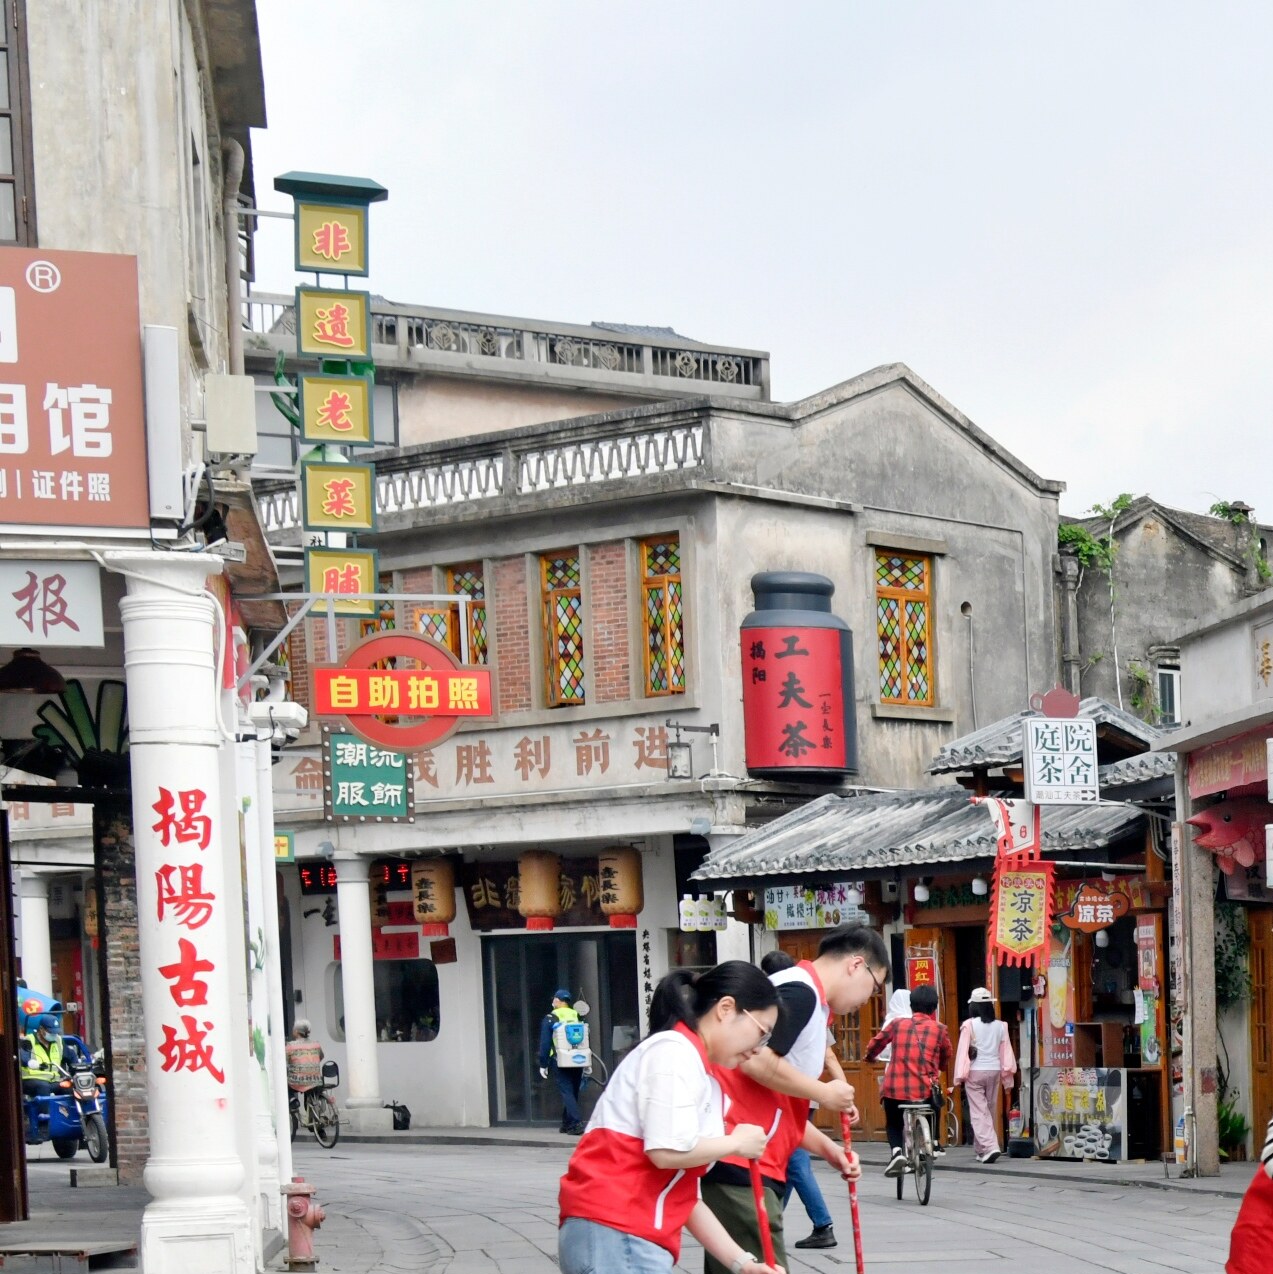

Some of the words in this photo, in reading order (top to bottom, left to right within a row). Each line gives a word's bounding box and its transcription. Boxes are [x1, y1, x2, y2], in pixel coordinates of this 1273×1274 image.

[311, 220, 361, 604] 非遗老菜脯
[32, 470, 111, 502] 证件照
[12, 570, 80, 638] 报
[749, 641, 766, 685] 揭阳
[330, 675, 479, 710] 自助拍照
[775, 635, 817, 758] 工夫茶
[336, 742, 403, 768] 潮流
[1034, 723, 1092, 752] 庭院
[1036, 755, 1093, 784] 茶舍
[1035, 790, 1081, 800] 潮汕工夫茶
[152, 786, 226, 1084] 揭陽古城
[1008, 890, 1035, 941] 凉茶
